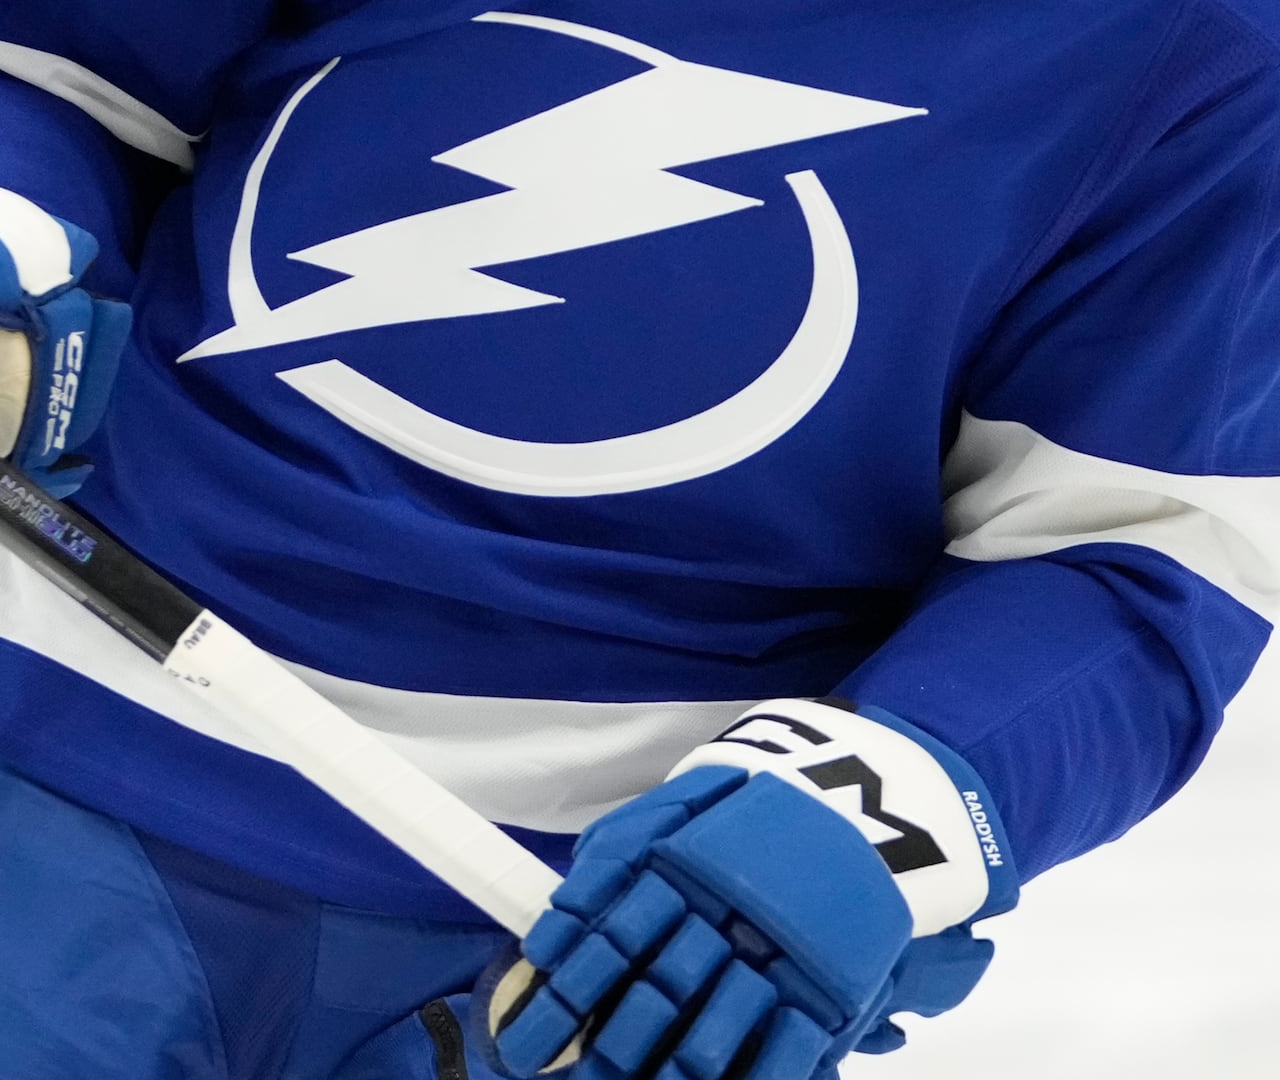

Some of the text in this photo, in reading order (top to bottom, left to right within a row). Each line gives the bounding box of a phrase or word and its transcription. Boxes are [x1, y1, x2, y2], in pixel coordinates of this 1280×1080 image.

[52, 330, 86, 451] CCM
[0, 473, 98, 551] NANOLITE
[962, 790, 1004, 868] RADDYSH
